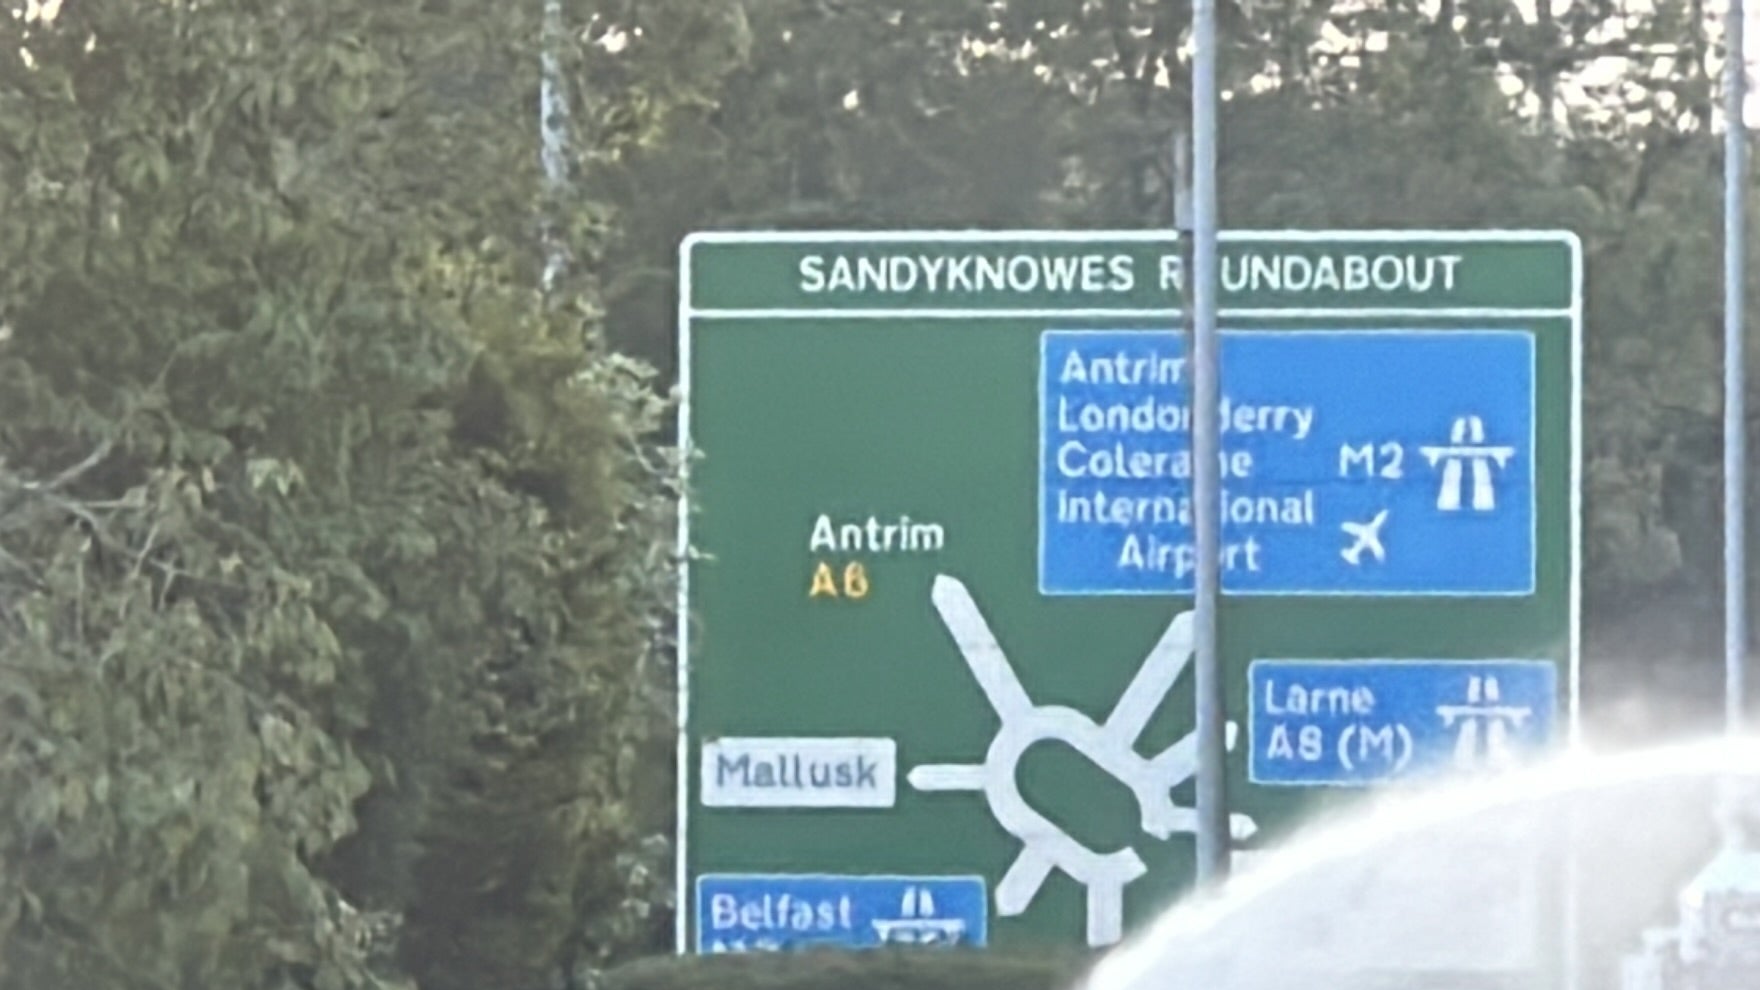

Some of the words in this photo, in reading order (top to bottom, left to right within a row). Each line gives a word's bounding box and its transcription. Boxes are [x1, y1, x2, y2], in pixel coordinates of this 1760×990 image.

[798, 254, 1136, 293] SANDYKNOWES
[1158, 254, 1463, 293] RUNDABOUT
[1339, 441, 1406, 479] M2
[809, 513, 946, 552] Antrim
[1265, 678, 1377, 717] Larne
[716, 753, 879, 789] Mallusk
